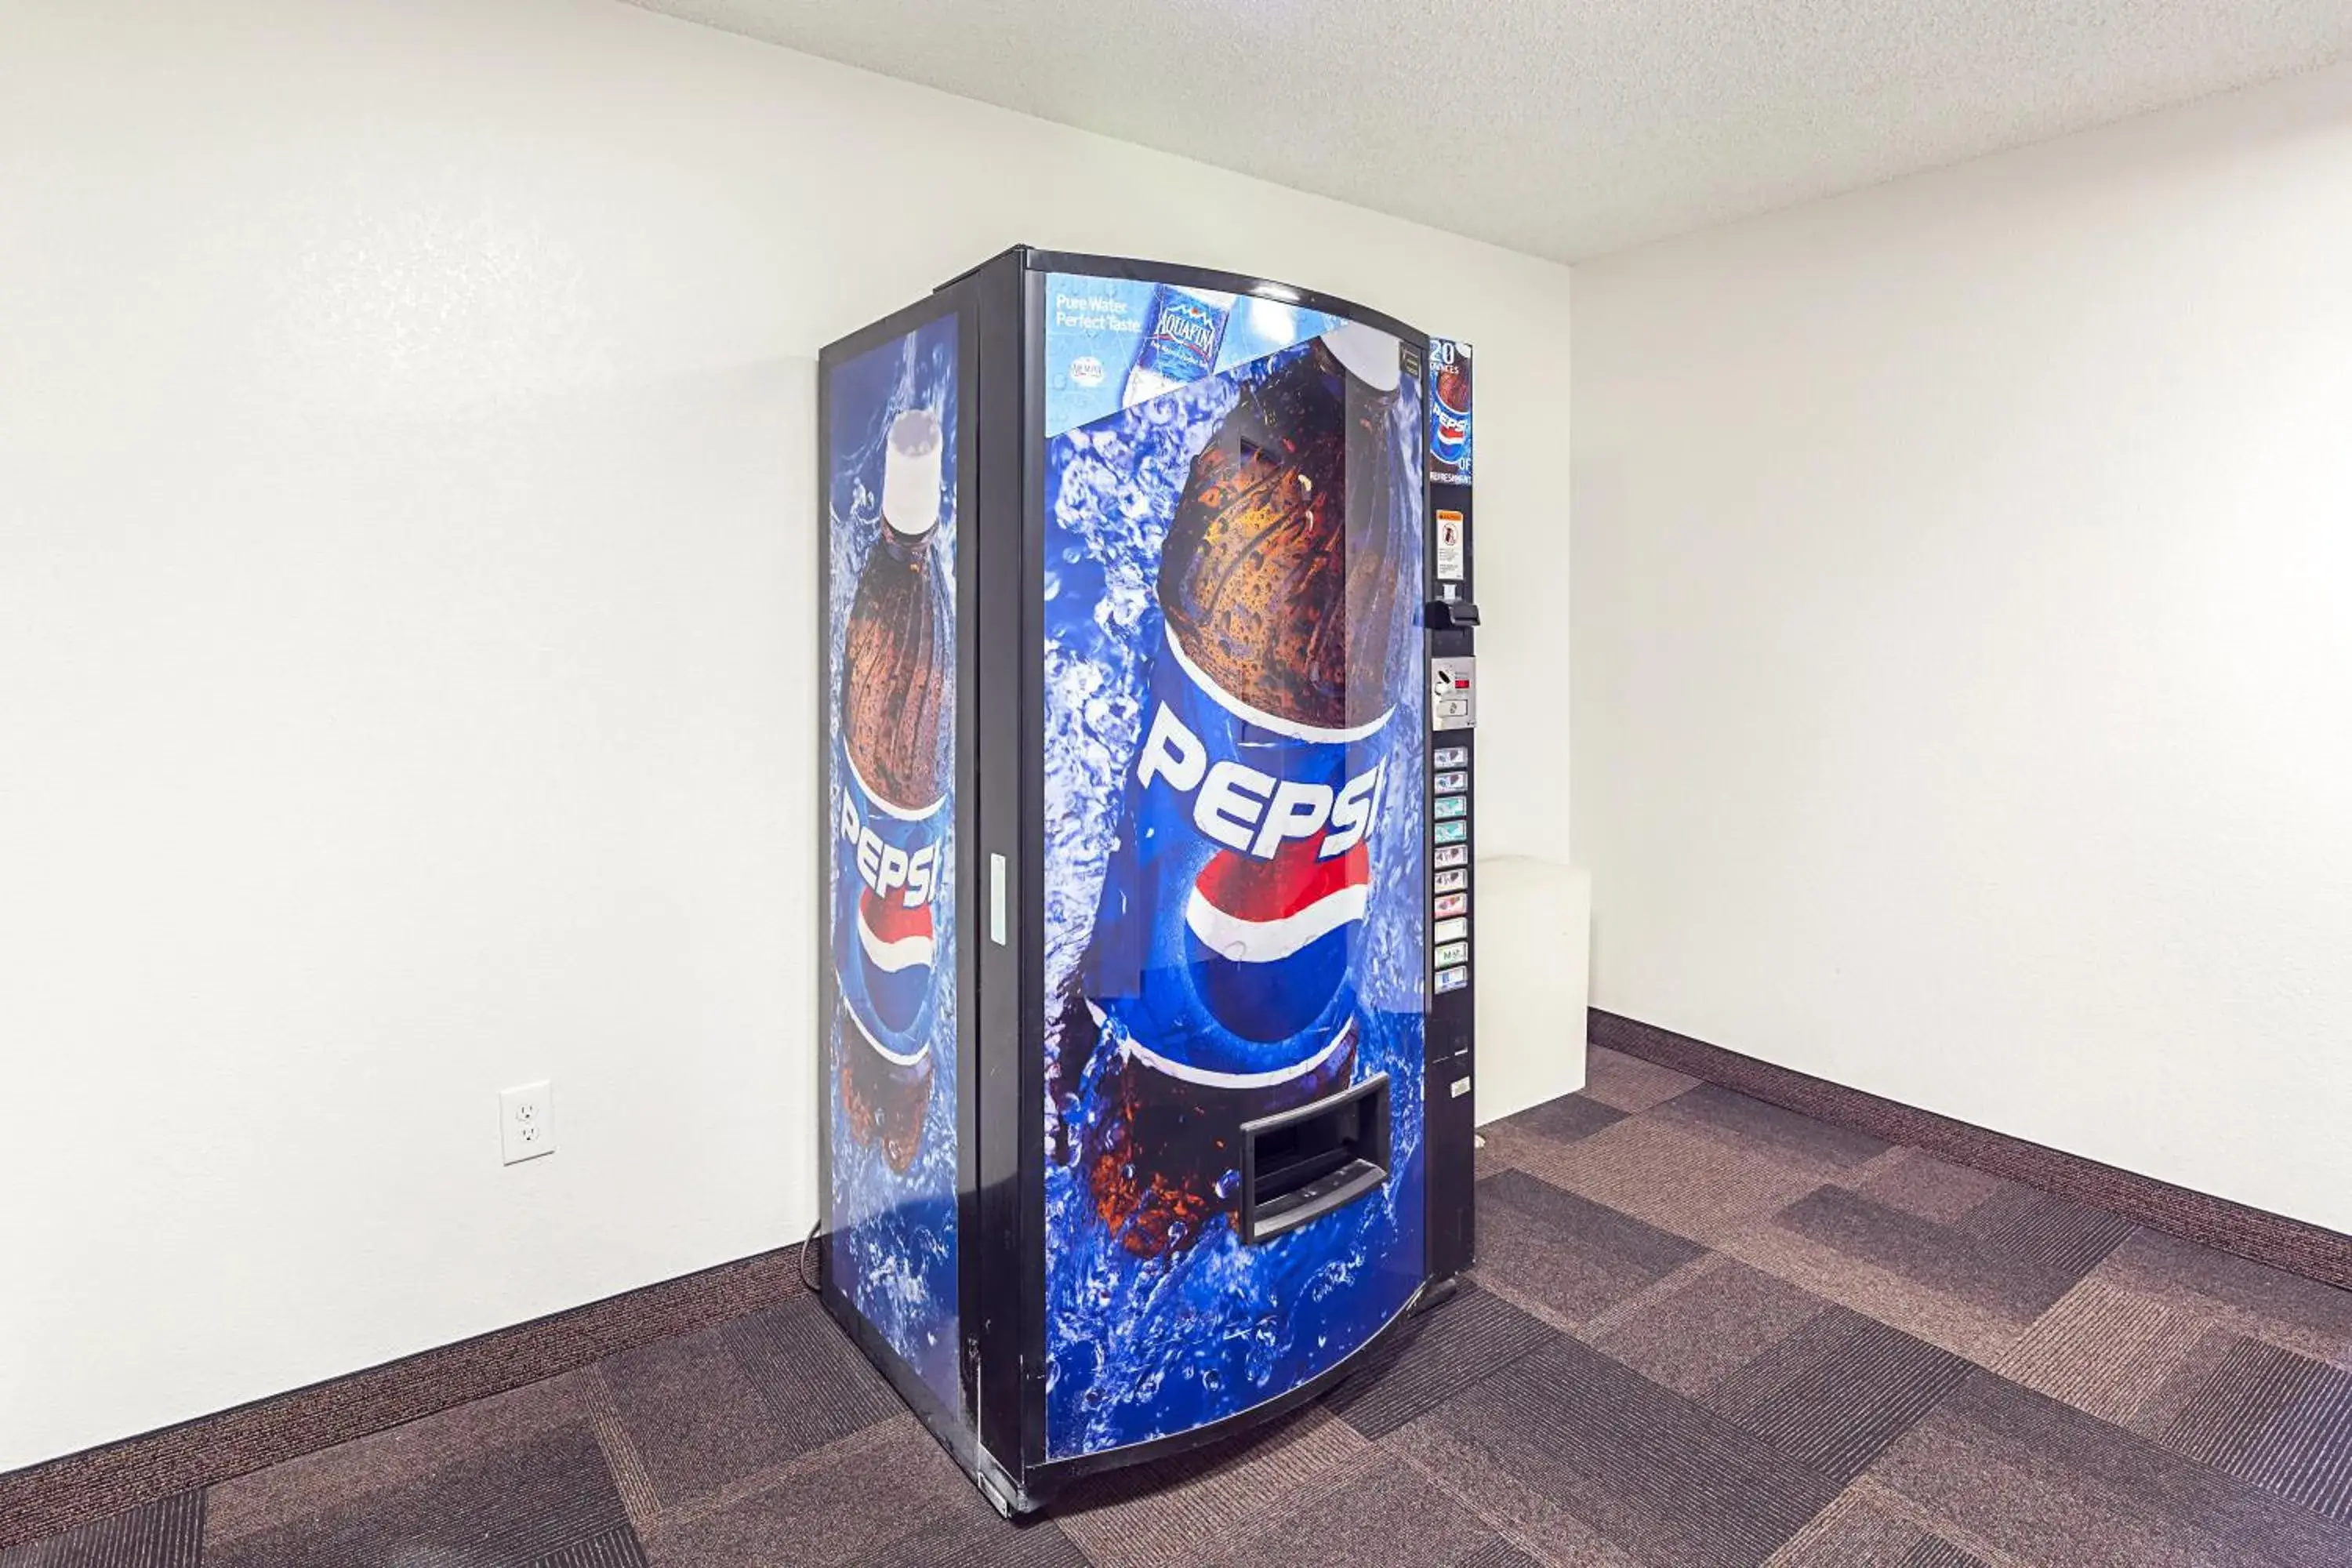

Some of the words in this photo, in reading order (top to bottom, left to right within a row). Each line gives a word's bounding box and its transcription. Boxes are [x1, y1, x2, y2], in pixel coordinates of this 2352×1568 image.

[1056, 292, 1087, 310] Pure
[1088, 296, 1127, 313] Water
[1056, 311, 1105, 329] Perfect
[1106, 314, 1142, 332] Taste
[1430, 339, 1454, 365] 20
[1459, 457, 1472, 470] OF
[1137, 699, 1387, 860] PEPSI
[841, 786, 941, 907] PEPSI
